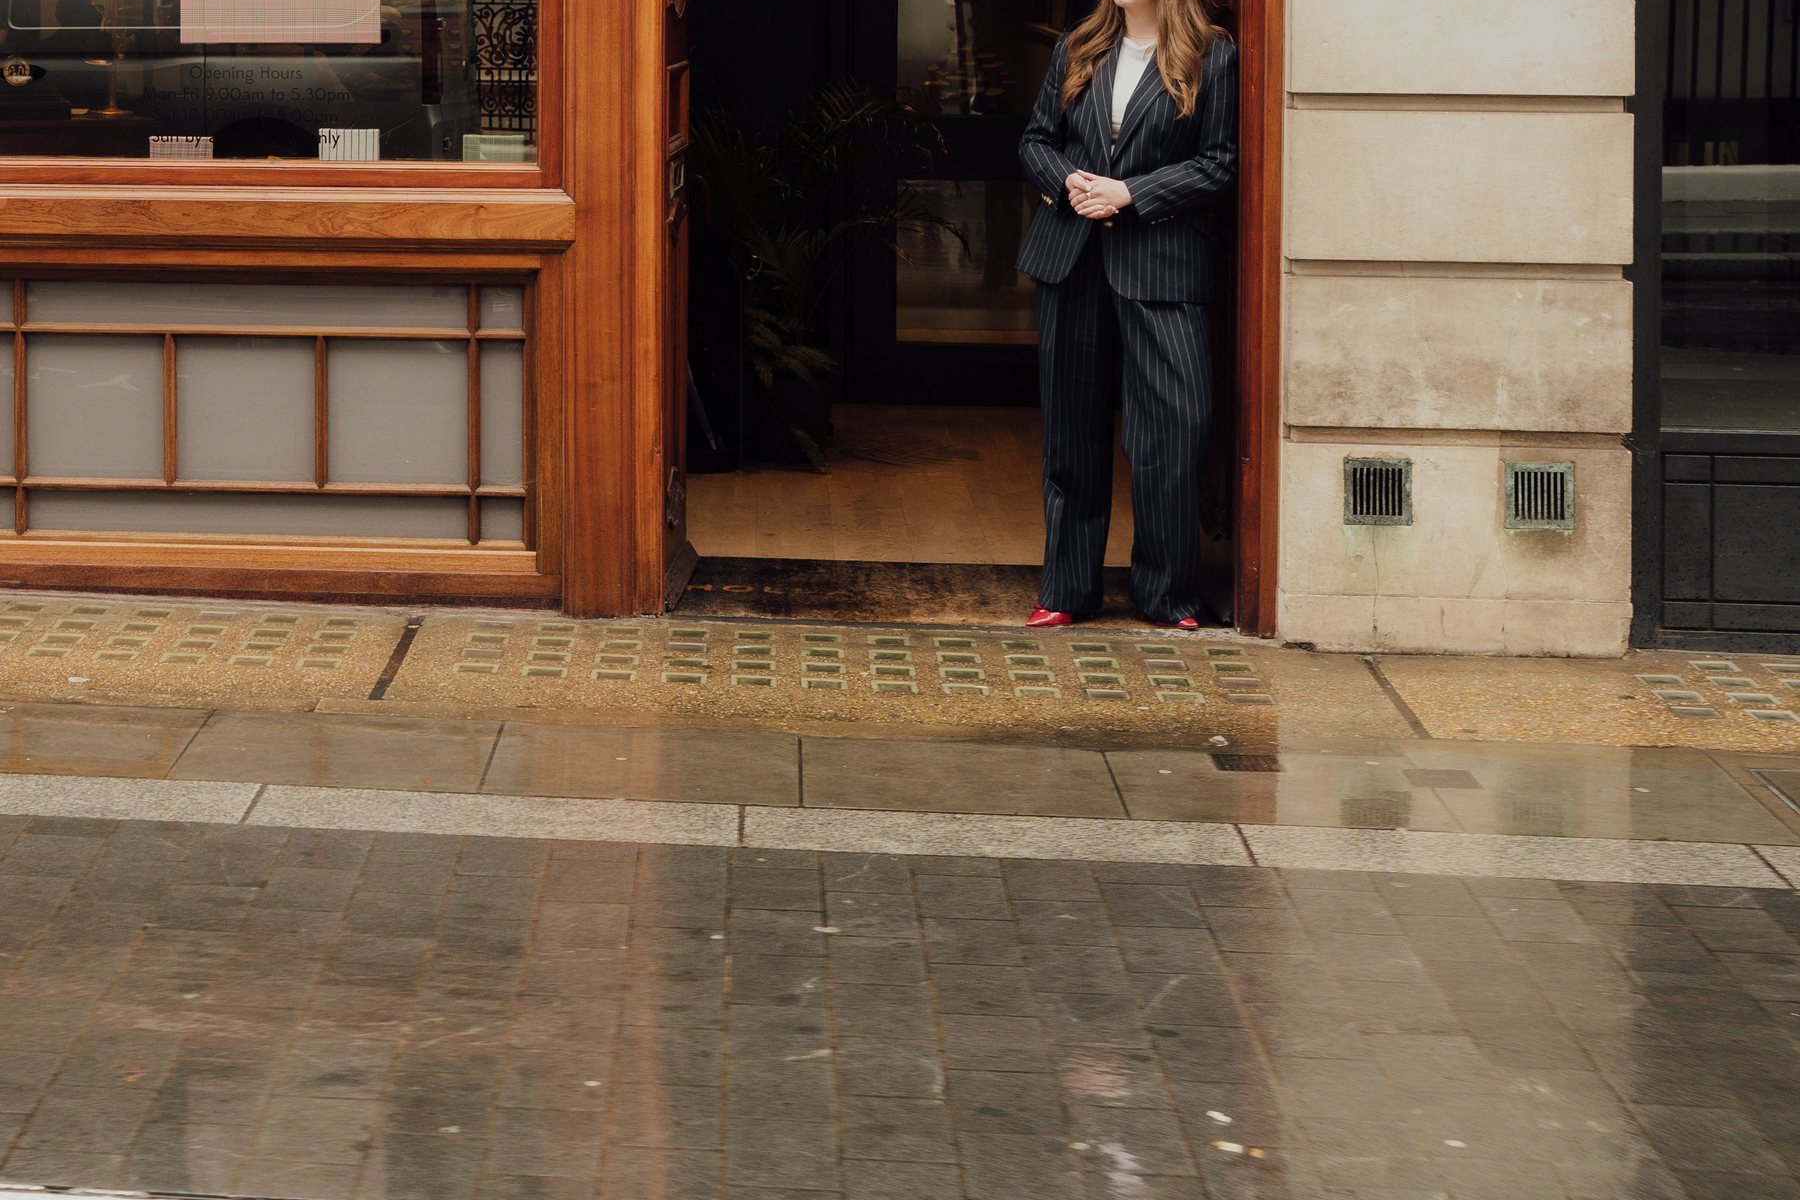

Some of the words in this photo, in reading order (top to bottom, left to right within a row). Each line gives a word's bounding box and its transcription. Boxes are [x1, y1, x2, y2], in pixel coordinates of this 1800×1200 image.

[189, 65, 254, 85] Opening
[260, 66, 303, 80] Hours
[205, 87, 264, 101] 9.00am
[271, 88, 285, 101] to
[291, 87, 350, 105] 5.30pm
